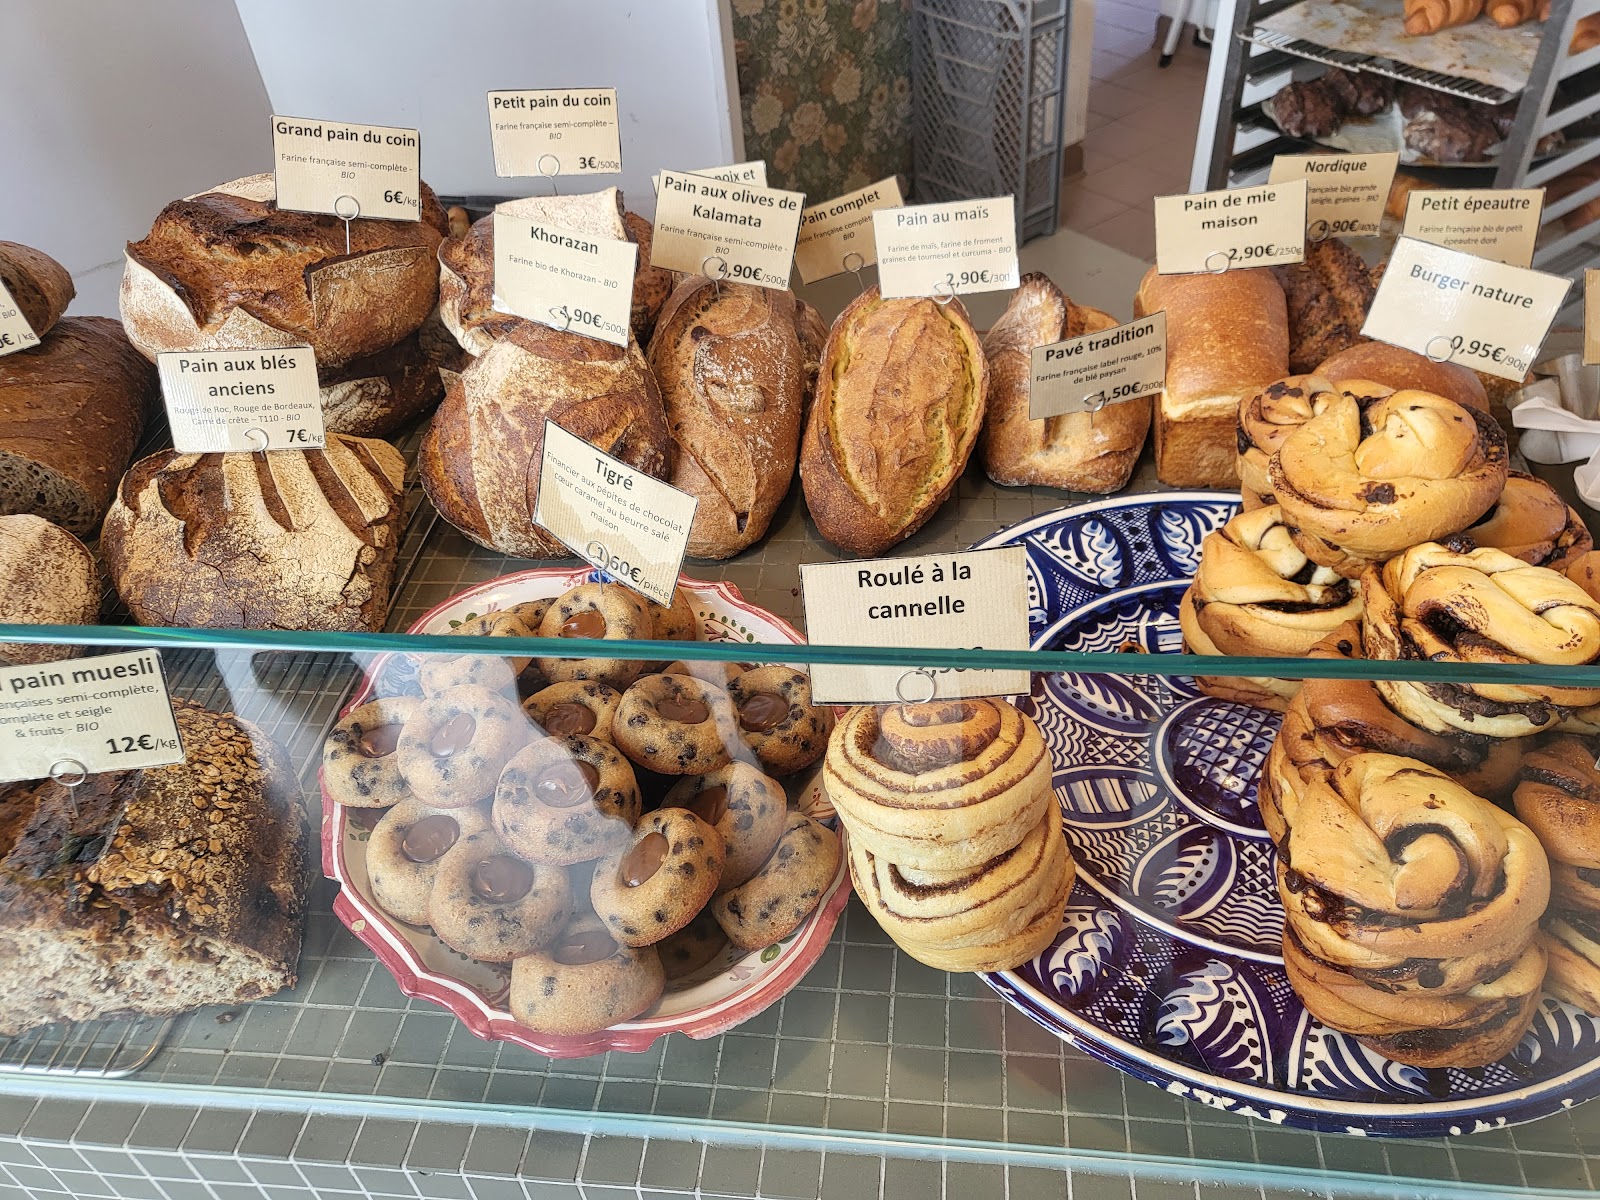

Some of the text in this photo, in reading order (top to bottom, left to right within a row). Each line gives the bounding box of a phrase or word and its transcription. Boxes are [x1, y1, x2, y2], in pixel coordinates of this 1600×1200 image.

[494, 94, 611, 111] Petit pain du coin
[277, 122, 415, 147] Grand pain du coin
[519, 122, 552, 131] française
[554, 120, 608, 129] semi-complète
[281, 153, 307, 163] Farine
[310, 156, 346, 168] française
[348, 161, 408, 173] semi-complète
[579, 156, 620, 170] 3€/500g
[1305, 160, 1367, 174] Nordique
[743, 169, 755, 180] et
[384, 190, 417, 207] 6€/kg
[664, 176, 797, 211] Pain aux olives de
[1184, 190, 1276, 212] Pain de mie
[801, 190, 881, 227] Pain complet
[1421, 196, 1530, 213] Petit épeautre
[693, 204, 762, 228] Kalamata
[897, 205, 989, 227] Pain au maïs
[1202, 215, 1258, 230] maison
[660, 223, 685, 235] Farine
[687, 228, 722, 243] française
[724, 236, 783, 253] semi-complète
[797, 214, 873, 246] arine française complèt
[843, 232, 855, 241] BIO
[1419, 224, 1523, 234] Farine française bio de petit
[531, 226, 598, 255] Khorazan
[715, 246, 730, 255] BIO
[888, 236, 1003, 253] Farine de maïs, farine de froment
[1443, 236, 1498, 245] épeautre doré
[882, 255, 906, 265] graines
[907, 254, 917, 262] de
[918, 252, 950, 261] tournesol
[961, 249, 992, 258] curcuma
[999, 246, 1012, 254] BIO
[509, 254, 533, 267] Farine
[535, 260, 547, 271] bio
[549, 265, 559, 274] de
[560, 267, 597, 284] Khorazan
[603, 279, 618, 289] BIO
[718, 262, 787, 287] 4,90€/500g
[946, 270, 1011, 288] 2,90€/300
[1410, 264, 1534, 309] Burger nature
[2, 309, 17, 319] BIO
[1045, 324, 1154, 362] Pavé tradition
[179, 354, 296, 373] Pain aux blés
[1036, 344, 1162, 382] Farine française label rouge, 10%
[1450, 335, 1526, 373] 0,95€/90g
[1073, 367, 1127, 385] de blé paysan
[208, 381, 275, 397] anciens
[202, 406, 212, 414] de
[214, 406, 232, 414] Roc,
[234, 404, 259, 415] Rouge
[262, 404, 272, 412] de
[274, 402, 315, 411] Bordeaux,
[216, 417, 226, 425] de
[228, 416, 249, 424] crête
[258, 415, 278, 423] T110
[286, 413, 300, 421] BIO
[286, 428, 323, 444] 7€/kg
[595, 457, 634, 491] Tigré
[546, 451, 684, 535] Financier aux pépites de chocolat,
[554, 472, 670, 543] cœur caramel au beurre salé
[590, 509, 619, 533] maison
[858, 561, 971, 588] Roulé à la
[868, 595, 965, 620] cannelle
[10, 671, 65, 694] pain
[72, 657, 154, 685] muesli
[0, 684, 159, 711] ançaises semi-complète,
[0, 705, 113, 725] omplète et seigle
[15, 729, 27, 738] &
[29, 726, 65, 737] fruits
[76, 722, 99, 733] BIO
[106, 734, 178, 755] 12€/kg
